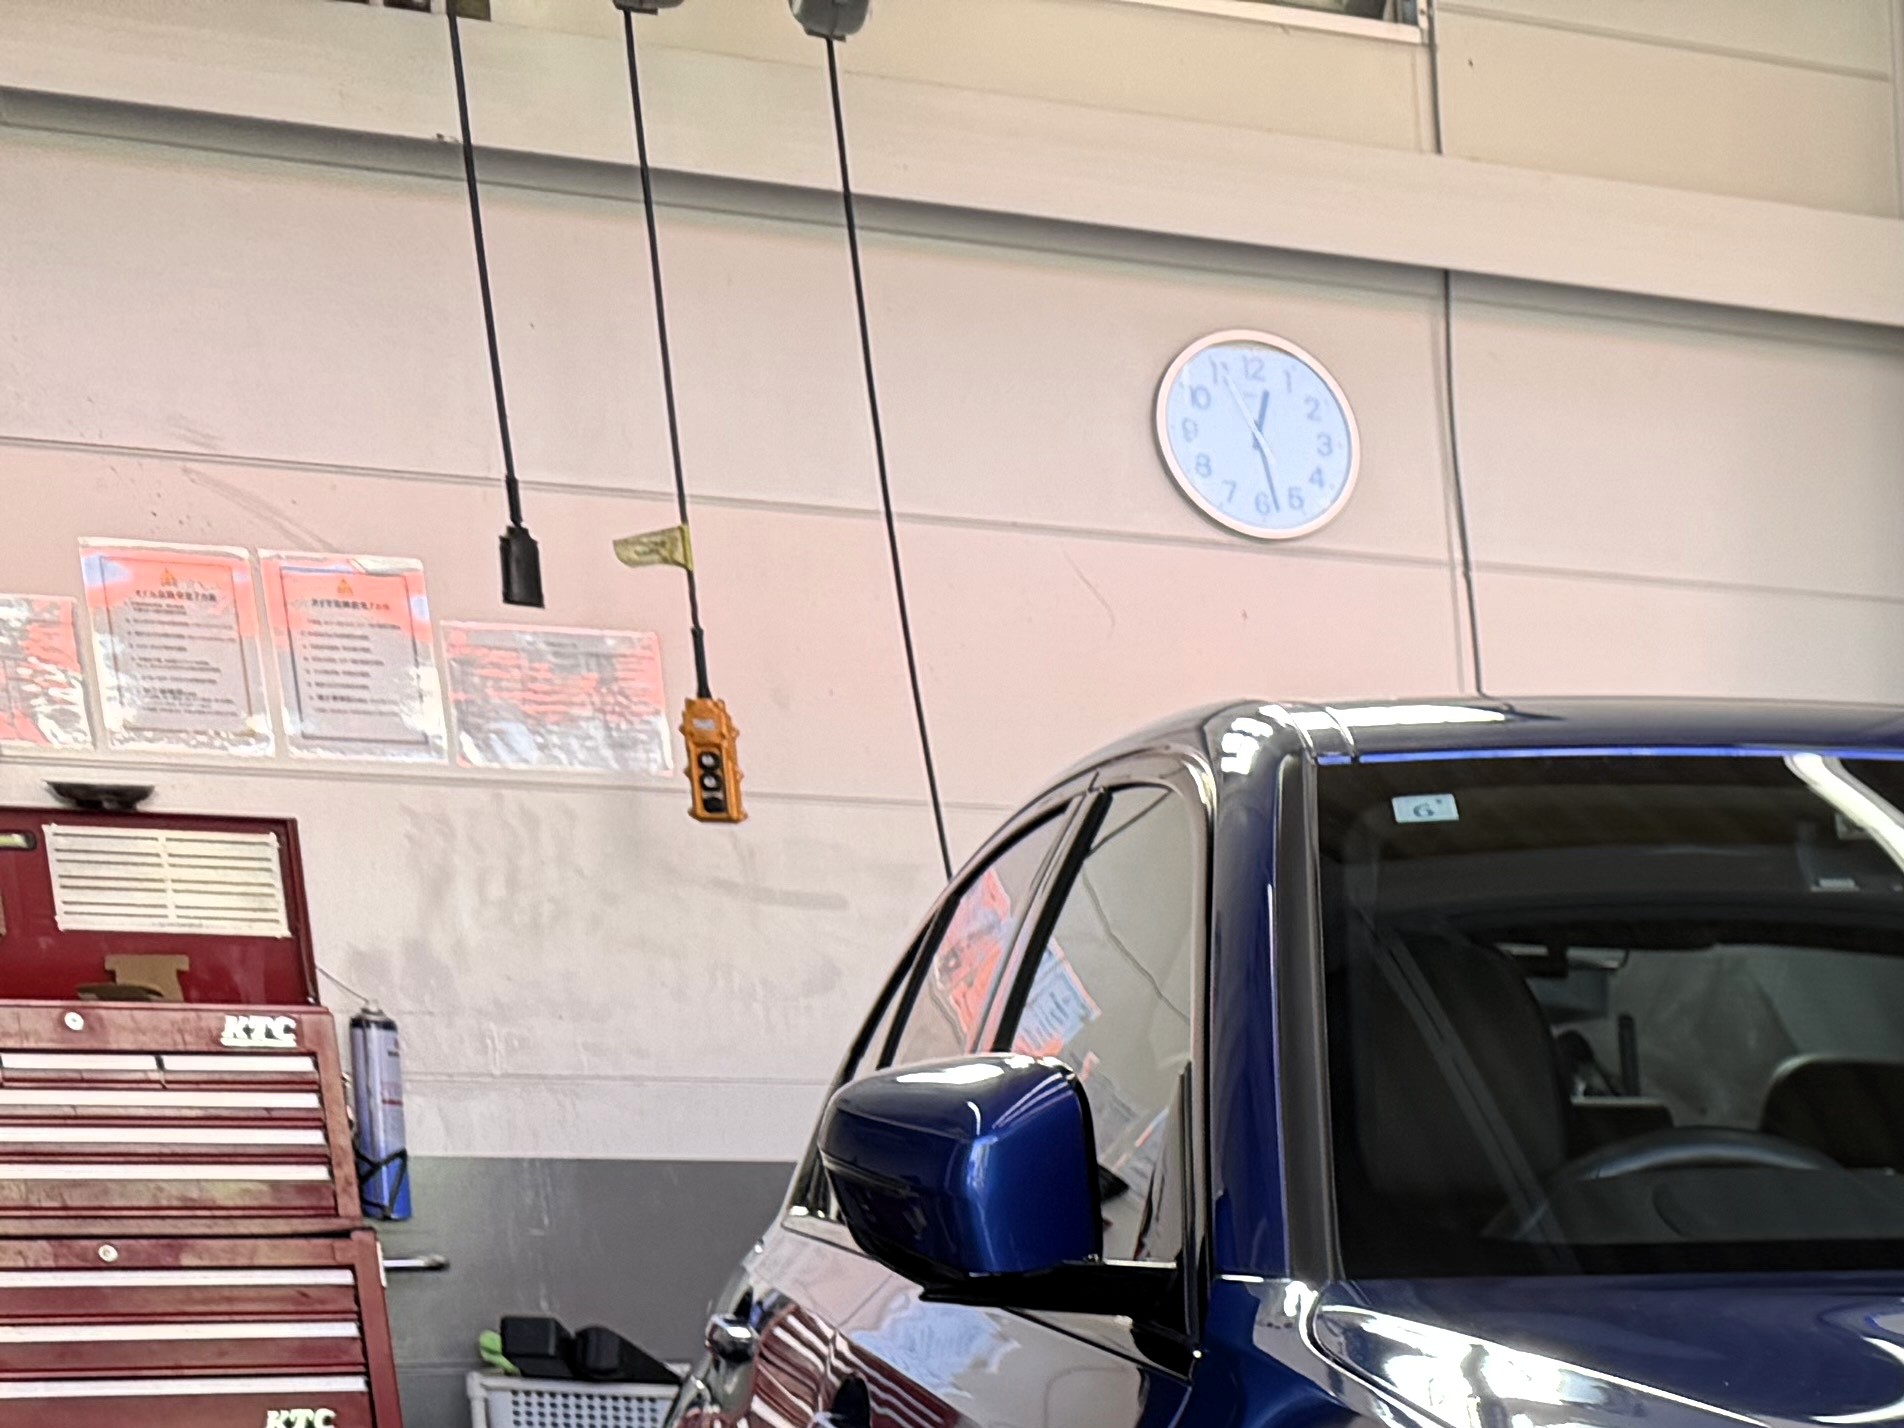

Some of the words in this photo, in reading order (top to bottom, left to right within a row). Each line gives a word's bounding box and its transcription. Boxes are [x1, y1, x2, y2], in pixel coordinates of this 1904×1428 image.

[1243, 356, 1265, 381] 12
[1191, 385, 1212, 410] 10
[1305, 397, 1322, 422] 2
[1183, 417, 1198, 443] 9
[1316, 432, 1333, 457] 3
[1196, 454, 1213, 479] 8
[1308, 468, 1325, 489] 4
[1223, 481, 1238, 504] 7
[1255, 492, 1270, 515] 6
[1289, 488, 1305, 511] 5
[220, 1014, 297, 1044] KTC
